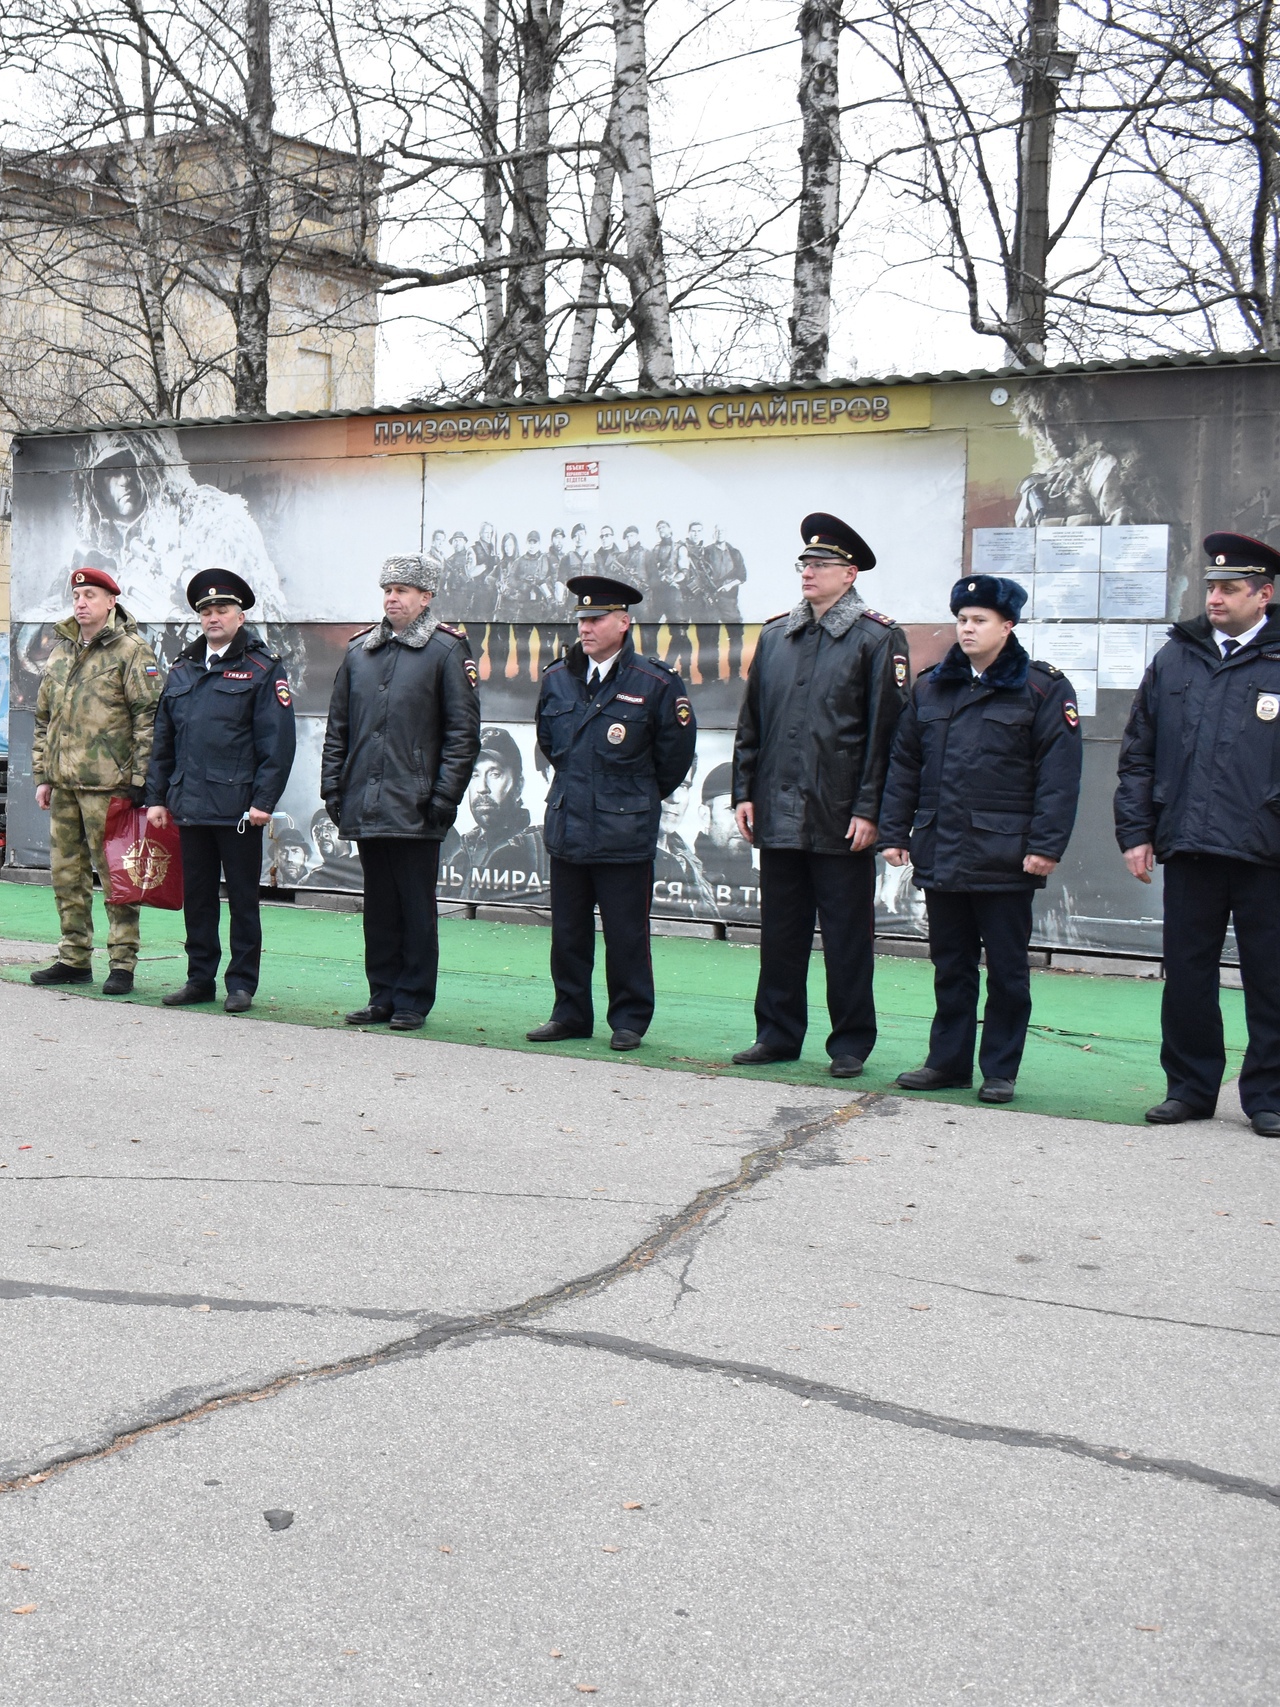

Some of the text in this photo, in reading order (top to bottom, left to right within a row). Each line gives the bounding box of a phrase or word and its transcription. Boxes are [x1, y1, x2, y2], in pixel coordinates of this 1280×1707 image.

[373, 395, 890, 446] ПРИЗОВОЙ ТИР ШКОЛА СНАЙПЕРОВ
[717, 884, 732, 906] В
